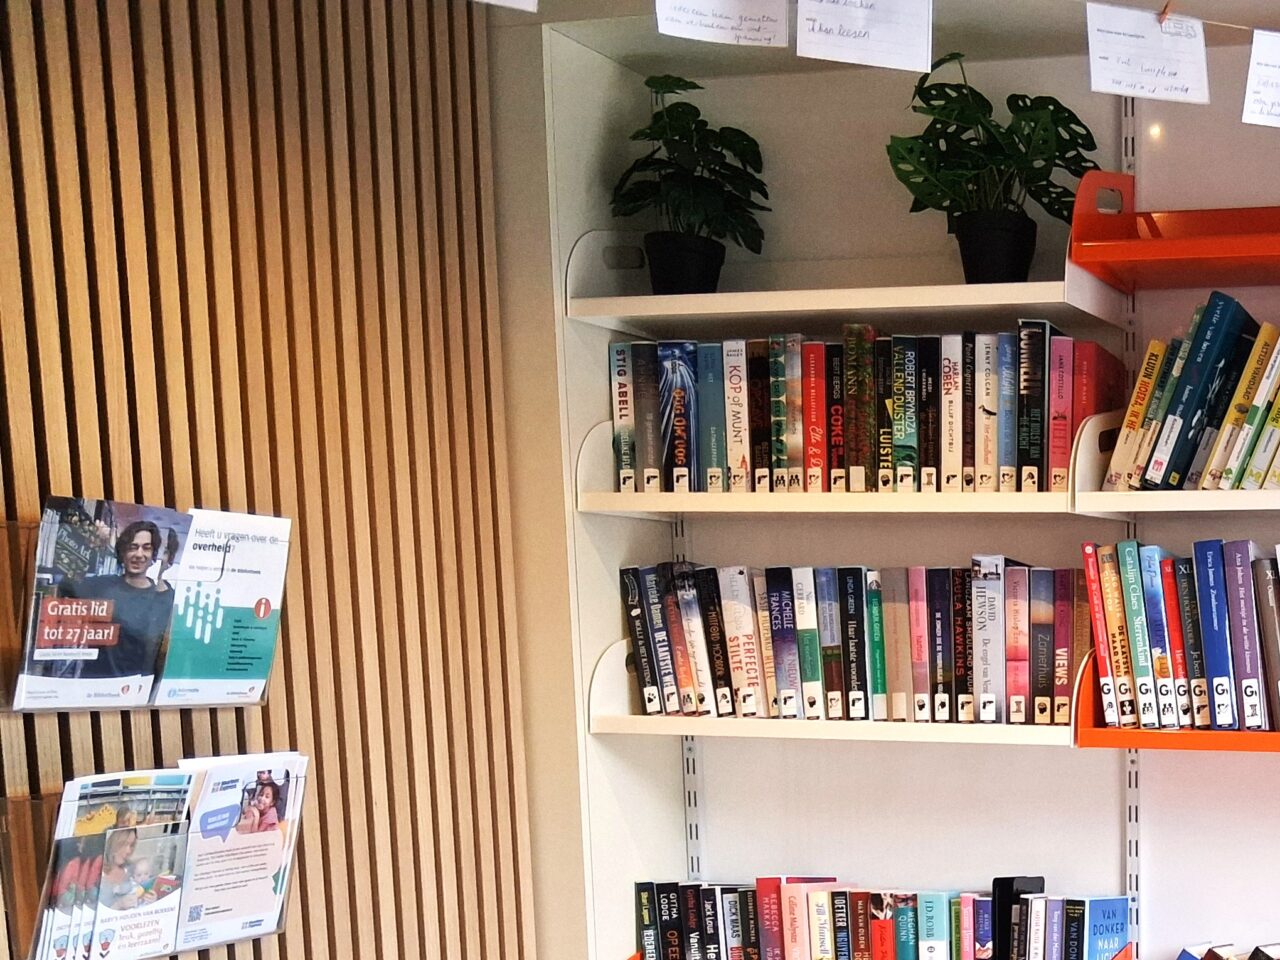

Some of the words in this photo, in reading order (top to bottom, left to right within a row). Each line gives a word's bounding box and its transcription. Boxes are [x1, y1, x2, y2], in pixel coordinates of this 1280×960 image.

[616, 349, 626, 377] STIG
[894, 346, 904, 393] VALLEND
[905, 352, 915, 388] ROBERT
[1020, 331, 1041, 395] CONNELLY
[1143, 352, 1159, 380] KLUUN
[729, 366, 741, 393] KOP
[943, 358, 952, 395] COBEN
[966, 364, 975, 395] Cognetti
[618, 382, 629, 419] ABELL
[731, 396, 742, 407] of
[905, 390, 915, 433] BRYNDZA
[732, 410, 742, 444] MUNT
[831, 405, 843, 445] COKE
[894, 396, 904, 439] DUISTER
[810, 426, 823, 443] Elle
[192, 543, 235, 553] overheid?
[195, 528, 214, 538] Heeft
[224, 531, 249, 542] vragen
[251, 535, 267, 543] over
[1235, 552, 1243, 565] Ana
[646, 574, 660, 603] Marieke
[954, 570, 962, 609] PAULA
[1124, 548, 1136, 583] Catalijn
[1130, 585, 1139, 610] Claes
[48, 601, 87, 616] Gratis
[90, 601, 107, 616] lid
[651, 604, 663, 628] Damen
[771, 593, 781, 630] FRANCES
[782, 591, 793, 629] MICHELLE
[976, 586, 987, 631] HEWSON
[988, 597, 996, 621] DAVID
[44, 628, 62, 640] tot
[66, 629, 80, 640] 27
[82, 626, 113, 643] jaar!
[635, 620, 644, 639] MOLLY
[654, 631, 666, 641] DE
[848, 621, 858, 638] Haar
[1118, 625, 1125, 635] DE
[1133, 616, 1149, 666] Sterrenkind
[639, 646, 647, 657] HET
[729, 636, 742, 672] STILTE
[849, 640, 861, 662] laatste
[955, 617, 964, 676] HAWKINS
[983, 638, 990, 647] De
[656, 643, 673, 674] LAATSTE
[742, 634, 758, 688] PERFECTE
[1038, 634, 1050, 688] Zomerhuis
[1056, 648, 1068, 685] VIEWS
[1120, 639, 1130, 676] LAATSTE
[1193, 660, 1201, 677] bent
[660, 894, 669, 920] LODGE
[669, 893, 678, 919] GYTHA
[686, 889, 695, 908] Gytha
[704, 901, 713, 916] Jack
[728, 901, 738, 916] DICK
[924, 900, 934, 914] J.D.
[688, 909, 697, 928] Lodge
[762, 897, 770, 928] MAKKAI
[770, 894, 778, 932] REBECCA
[1102, 910, 1117, 919] VAN
[120, 919, 160, 932] VOORLEZEN
[667, 930, 677, 945] OP
[706, 917, 714, 934] Lous
[730, 919, 740, 938] MAAS
[900, 916, 909, 941] QUINN
[925, 915, 935, 938] ROBB
[1069, 922, 1078, 939] VAN
[1093, 923, 1125, 936] DONKER
[688, 932, 700, 960] Vanuit
[1098, 939, 1119, 949] NAAR
